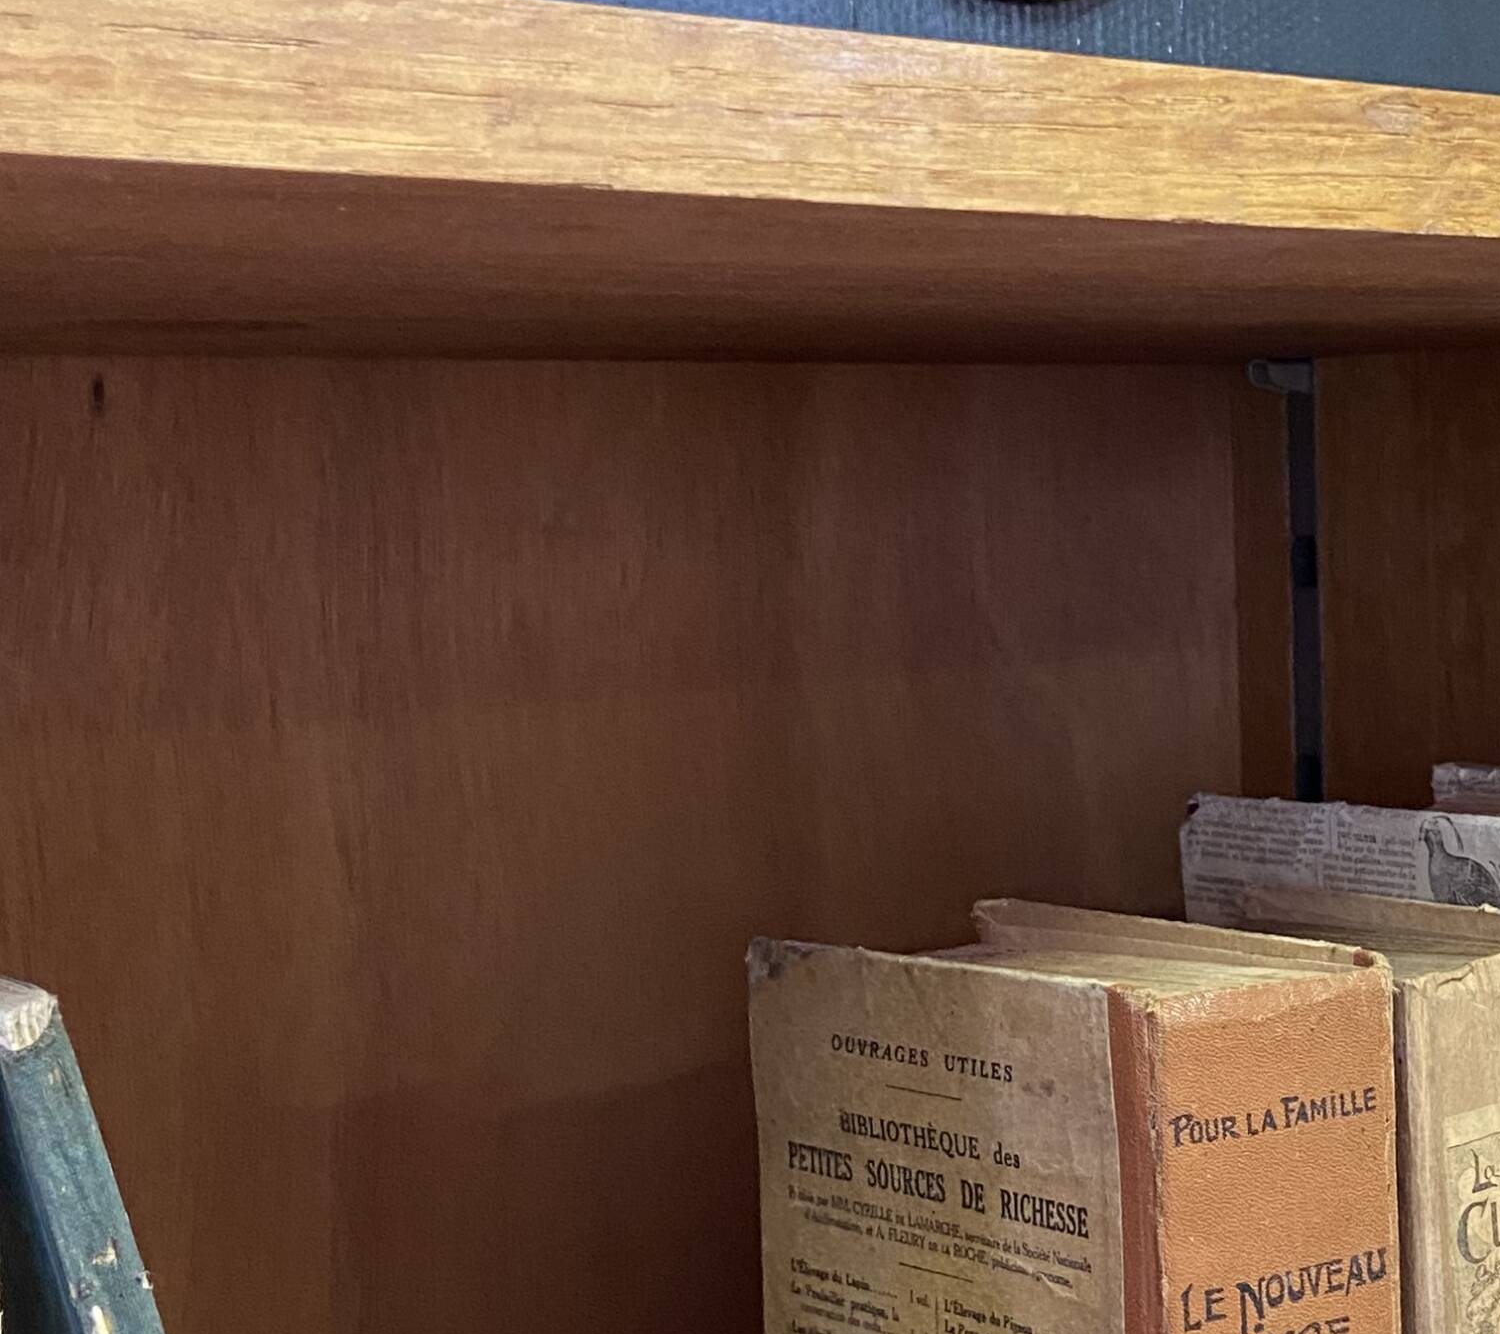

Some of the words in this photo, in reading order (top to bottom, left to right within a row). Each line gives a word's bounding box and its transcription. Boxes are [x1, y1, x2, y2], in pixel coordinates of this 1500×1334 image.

[831, 1033, 929, 1068] OUVRAGES
[944, 1054, 1013, 1083] UTILES
[840, 1111, 981, 1160] BIBLIOTHÈQUE
[993, 1143, 1020, 1169] des
[1169, 1113, 1238, 1148] POUR
[1246, 1110, 1277, 1135] LA
[1280, 1085, 1378, 1131] FAMILLE
[788, 1141, 853, 1181] PETITES
[867, 1159, 945, 1202] SOURCES
[961, 1179, 986, 1215] DE
[1000, 1189, 1089, 1239] RICHESSE
[888, 1227, 926, 1250] FLEURY
[989, 1311, 1001, 1327] du
[1181, 1282, 1228, 1333] LE
